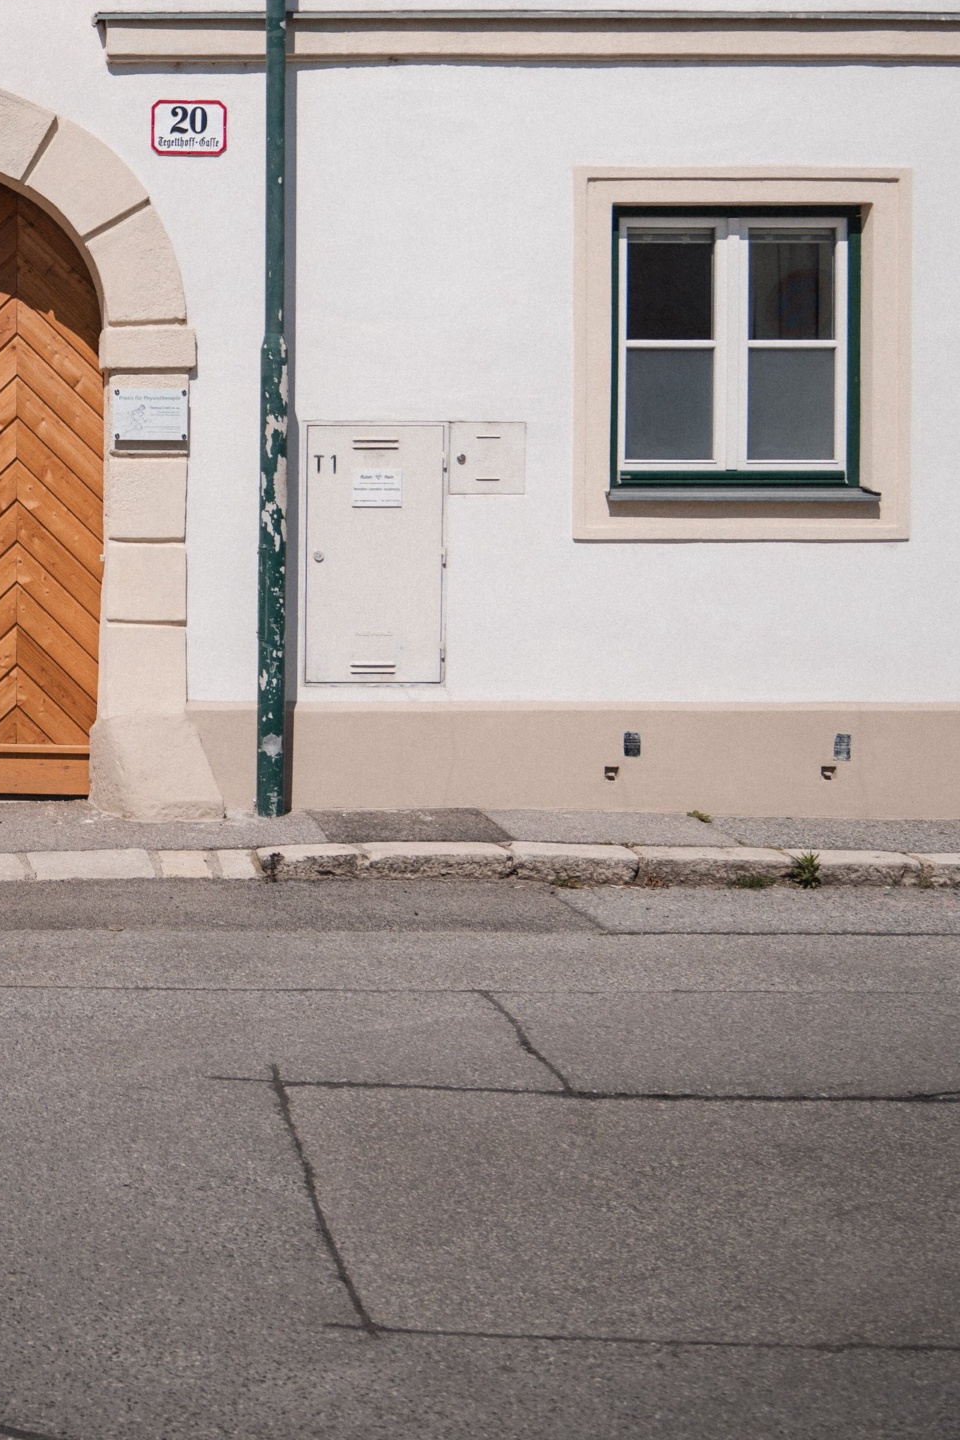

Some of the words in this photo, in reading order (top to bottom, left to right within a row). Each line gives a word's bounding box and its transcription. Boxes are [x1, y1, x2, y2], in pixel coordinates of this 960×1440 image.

[170, 106, 208, 134] 20
[313, 454, 325, 474] T
[330, 454, 337, 474] 1
